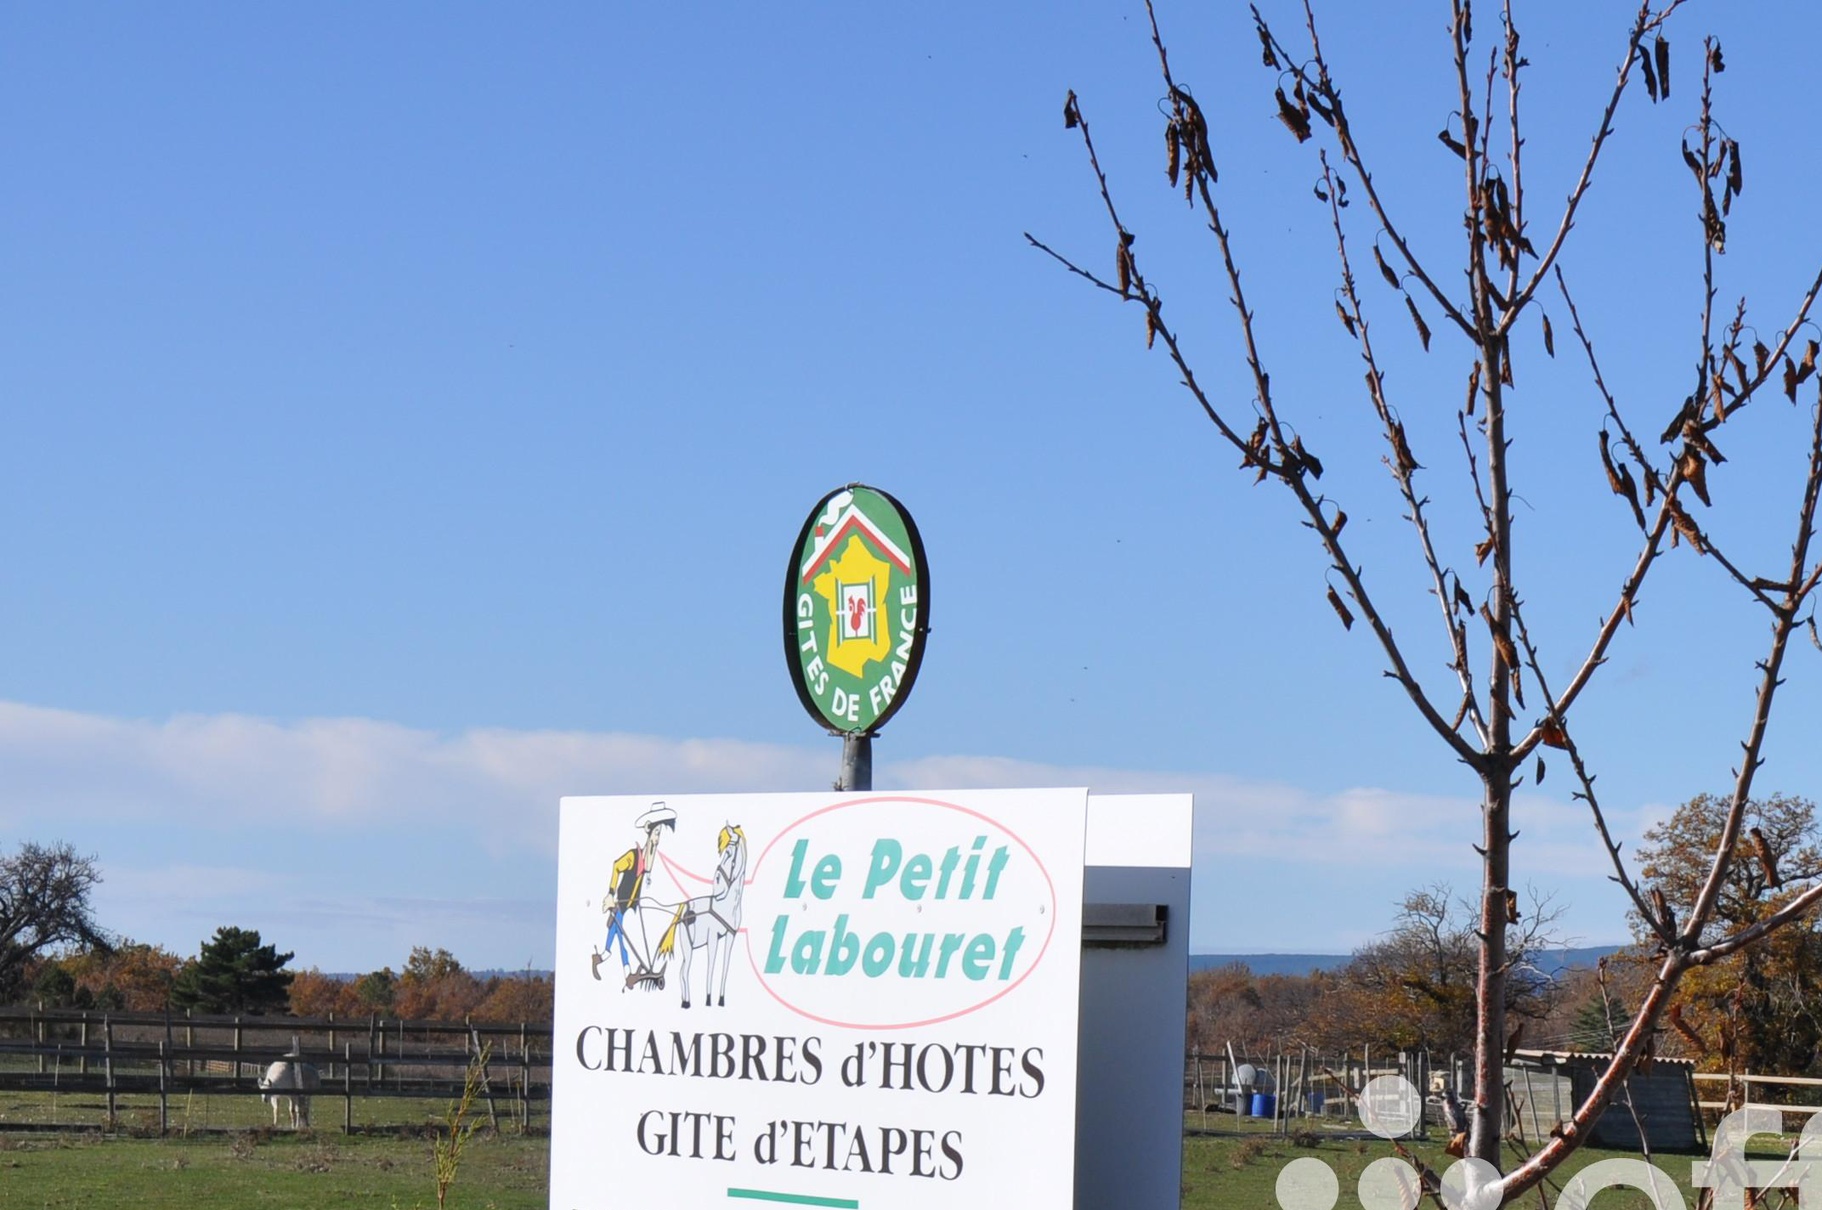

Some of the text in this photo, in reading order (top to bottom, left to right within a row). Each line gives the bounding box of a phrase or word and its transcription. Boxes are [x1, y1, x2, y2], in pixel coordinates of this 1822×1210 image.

[797, 583, 918, 722] GITES DE FRANCE
[783, 835, 1011, 901] Le Petit
[763, 914, 1026, 981] Labouret
[575, 1025, 1045, 1098] CHAMBRES d'HOTES
[636, 1109, 964, 1181] GITE d'ETAPES
